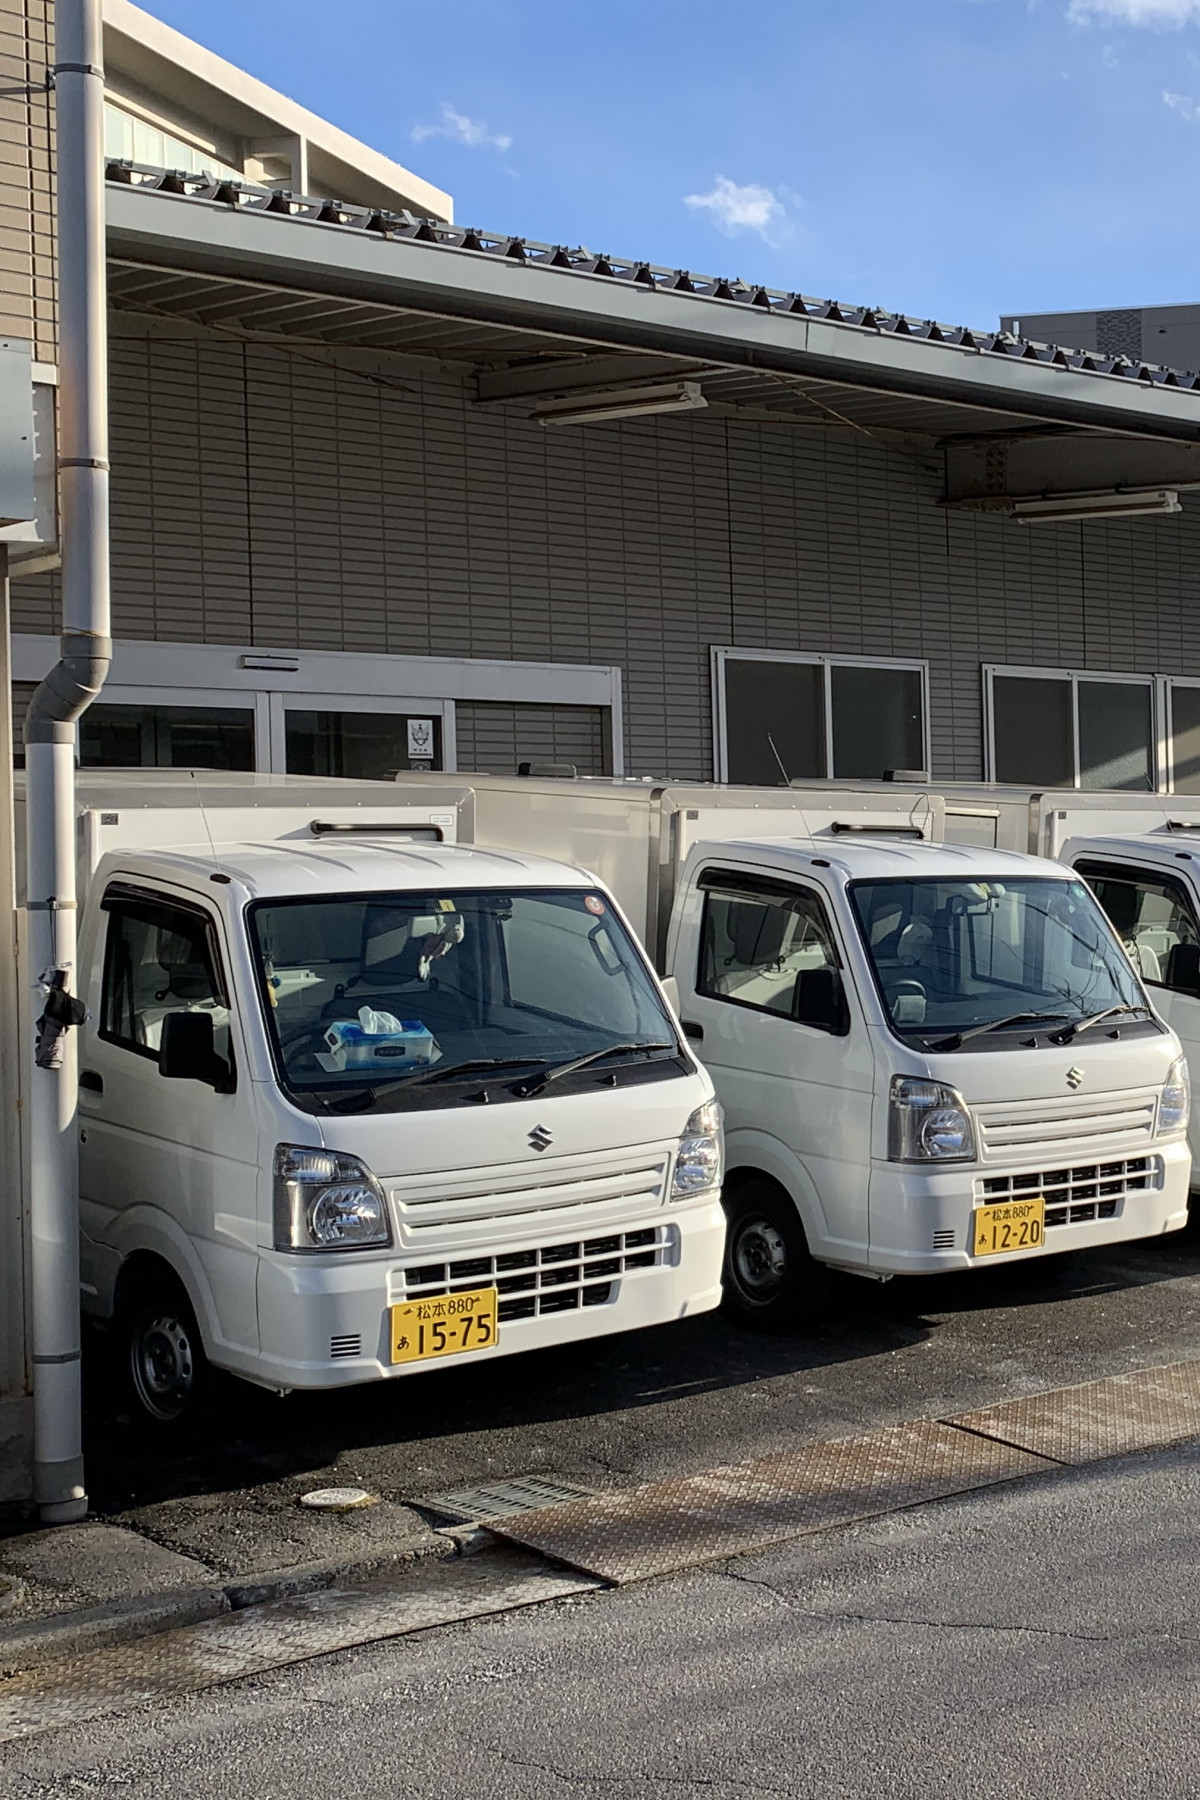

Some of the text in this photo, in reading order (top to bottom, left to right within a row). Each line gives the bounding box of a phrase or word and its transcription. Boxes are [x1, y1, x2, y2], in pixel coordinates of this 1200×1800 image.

[992, 1220, 1040, 1250] 12-20
[416, 1297, 474, 1320] 松本880
[397, 1313, 491, 1354] あ 15-75
